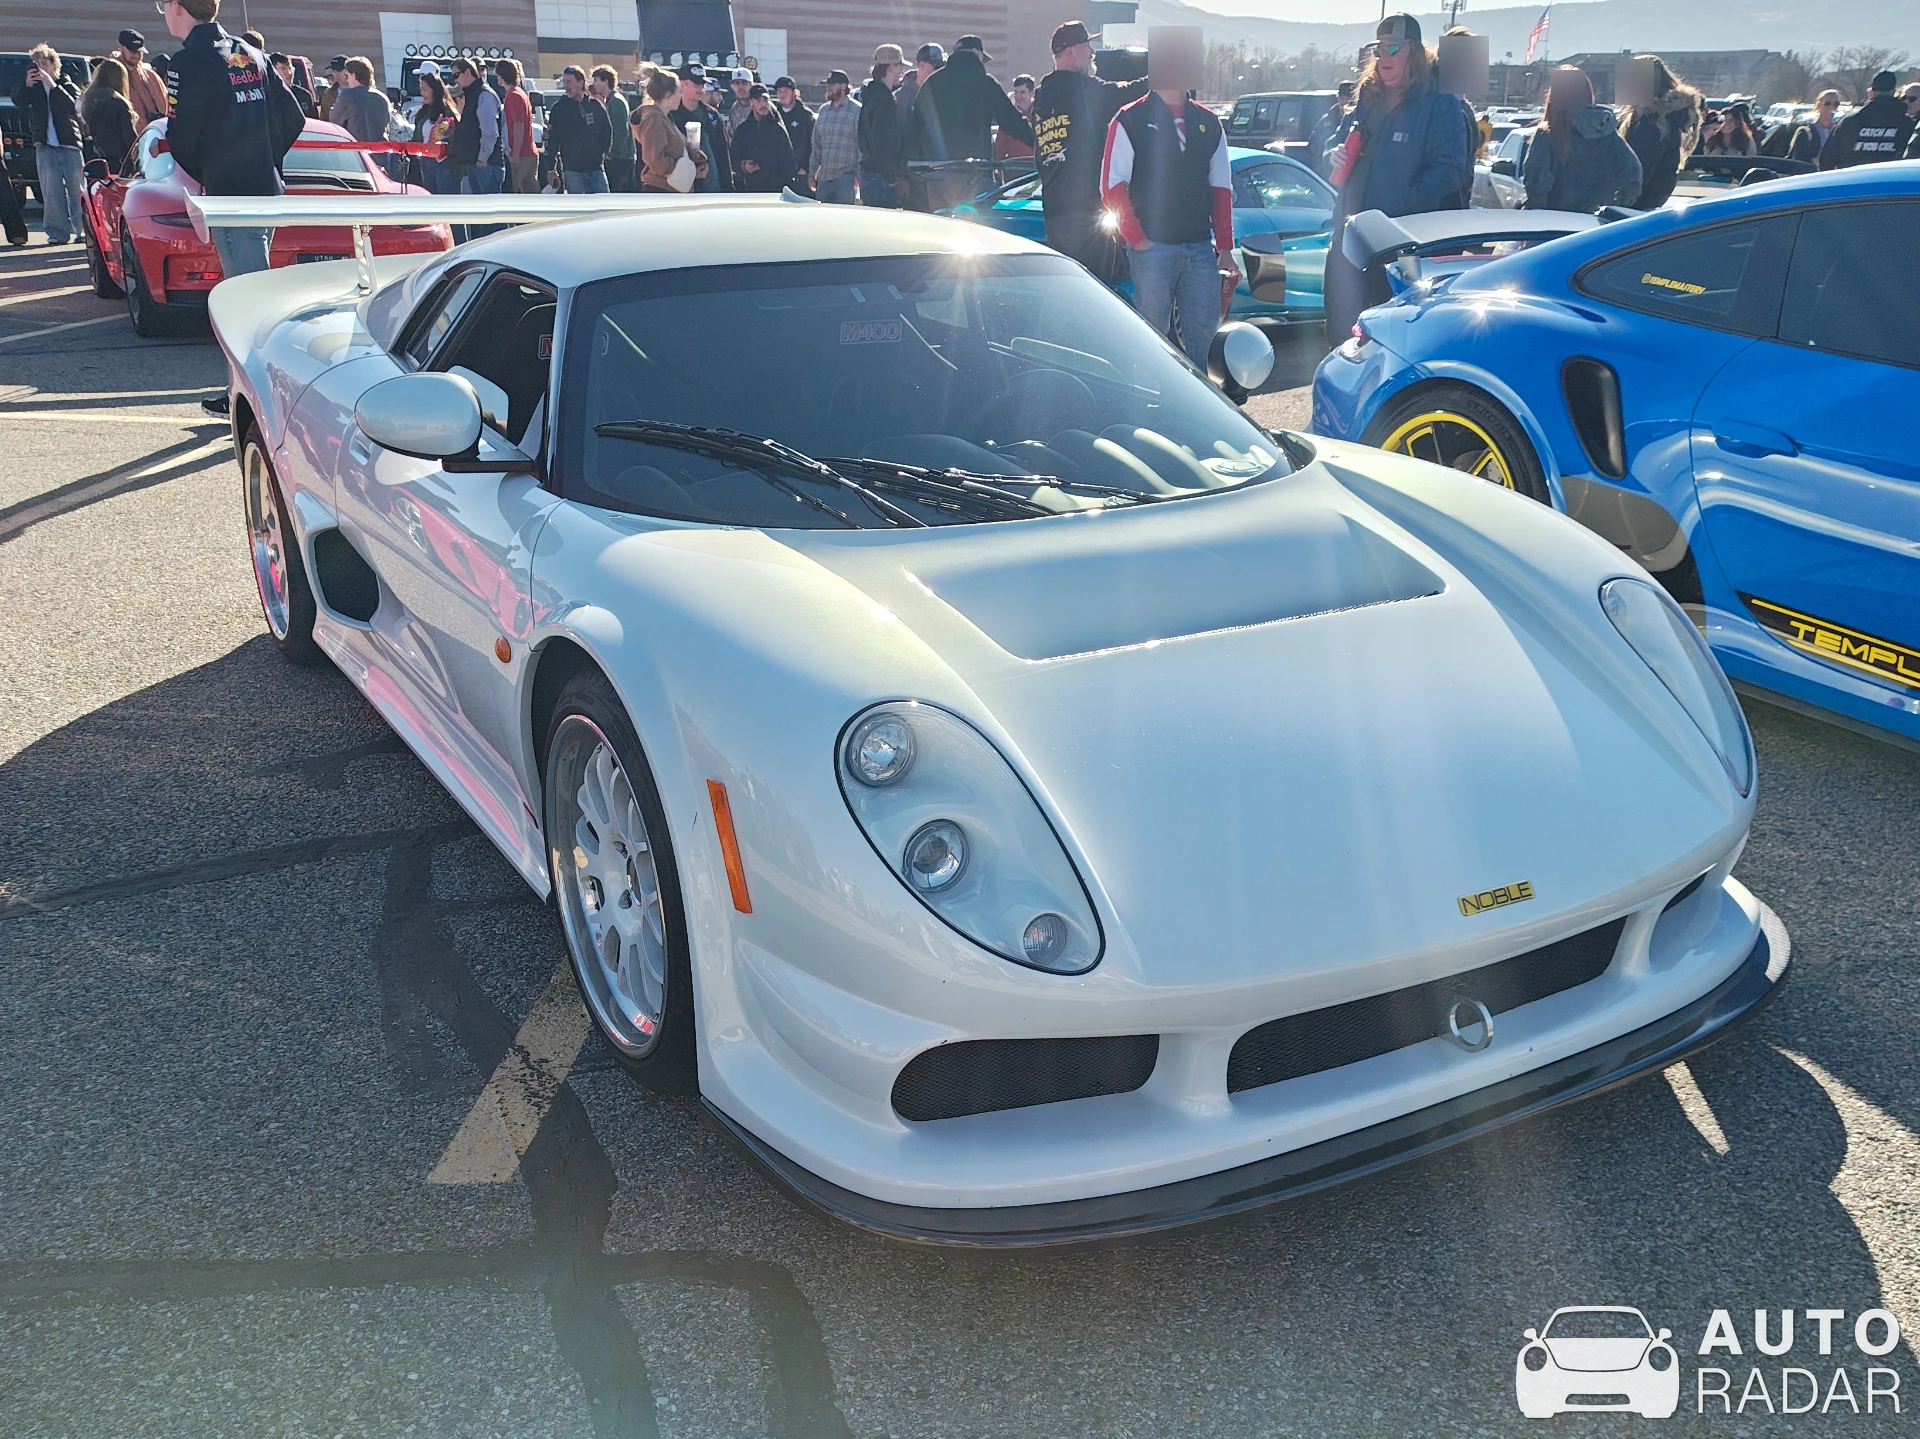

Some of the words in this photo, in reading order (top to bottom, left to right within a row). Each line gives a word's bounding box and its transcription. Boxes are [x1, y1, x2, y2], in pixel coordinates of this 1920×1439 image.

[1041, 141, 1063, 156] ARS
[842, 322, 900, 342] M400
[1461, 881, 1533, 914] NOBLE
